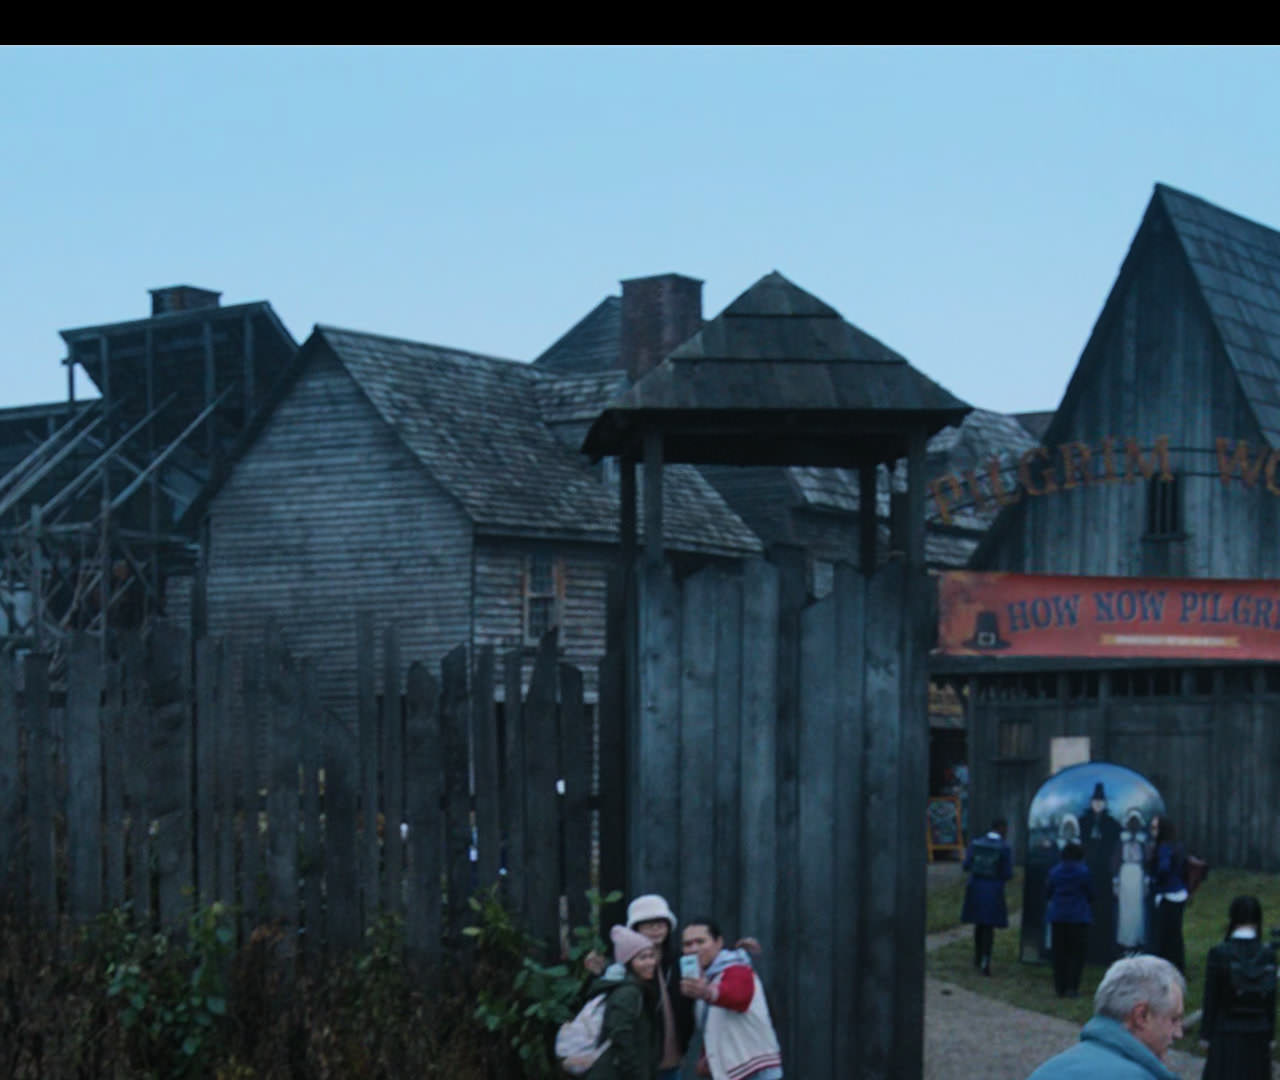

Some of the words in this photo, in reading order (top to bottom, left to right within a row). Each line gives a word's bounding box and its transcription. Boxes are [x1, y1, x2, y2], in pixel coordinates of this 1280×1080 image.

[928, 434, 1175, 525] PILGRIM
[1007, 594, 1081, 632] HOW
[1093, 590, 1167, 623] NOW
